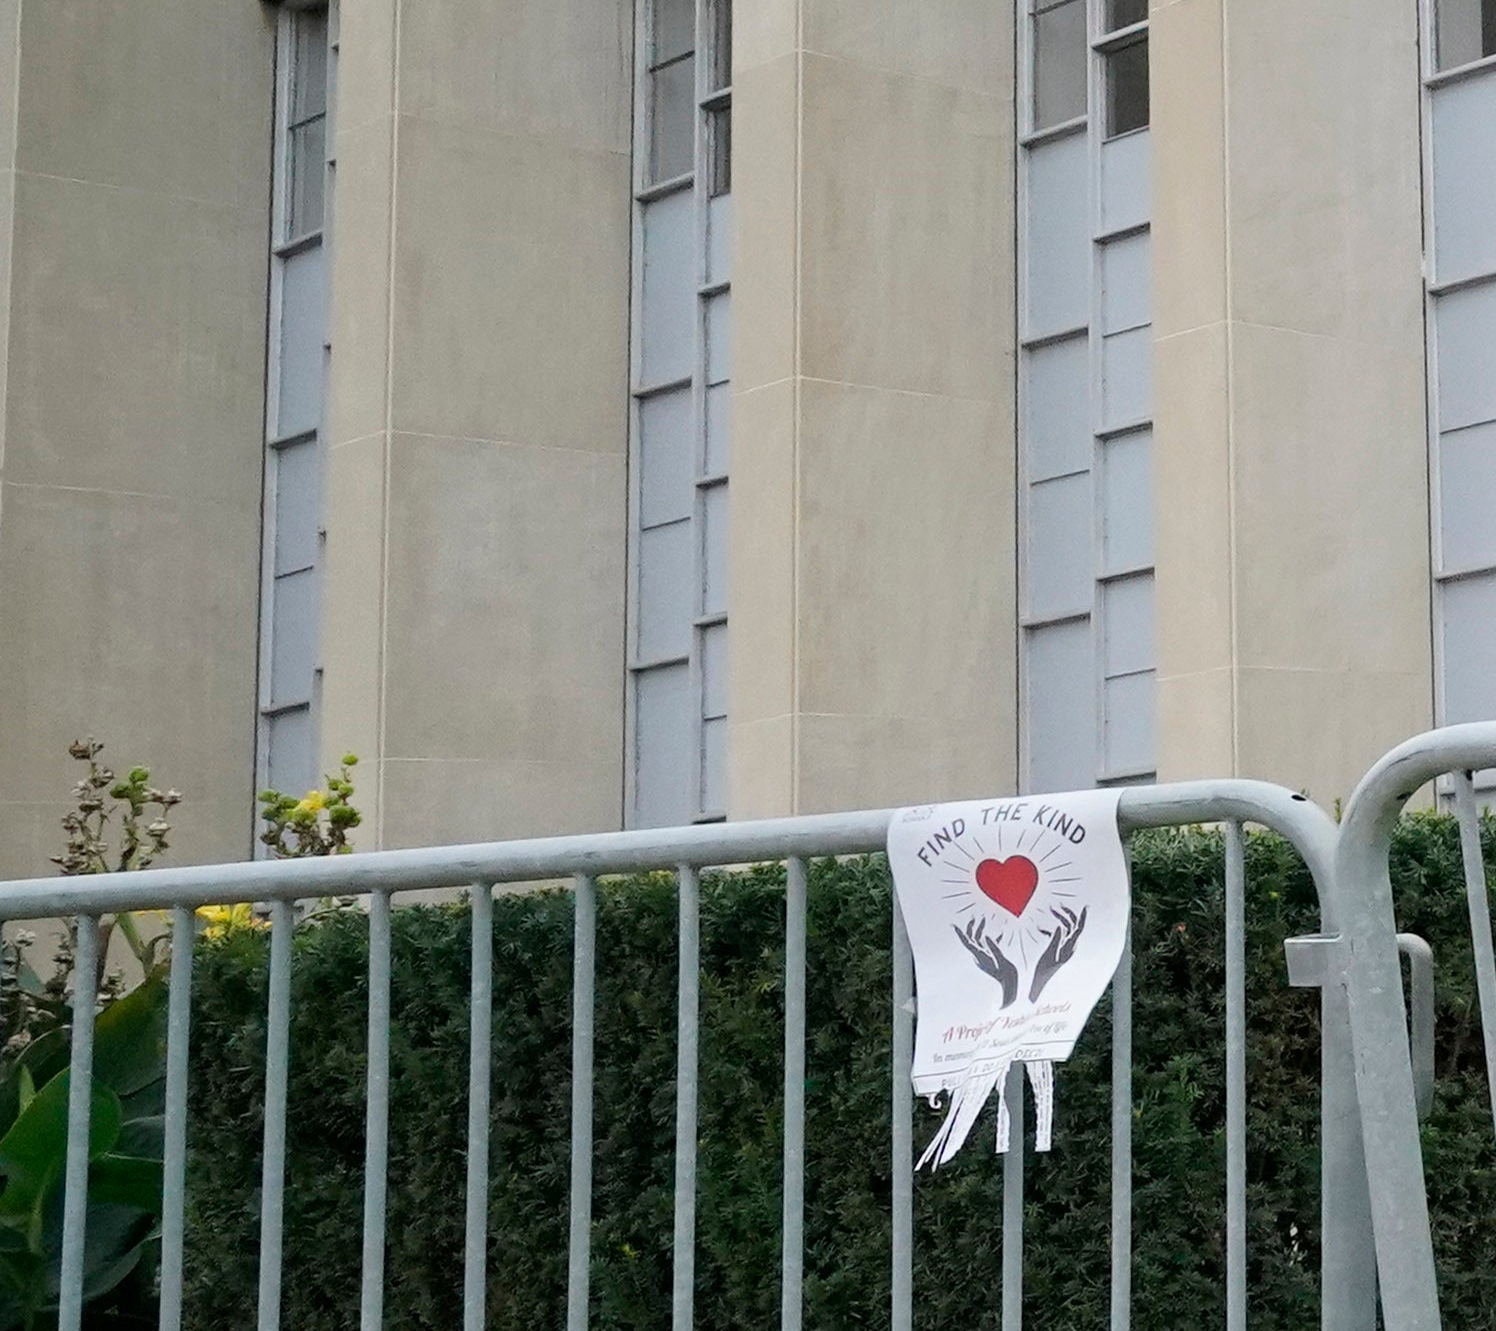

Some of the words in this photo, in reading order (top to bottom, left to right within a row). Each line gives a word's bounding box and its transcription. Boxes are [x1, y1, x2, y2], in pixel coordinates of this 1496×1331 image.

[916, 818, 966, 867] FIND
[981, 803, 1029, 825] THE
[1032, 805, 1086, 845] KIND
